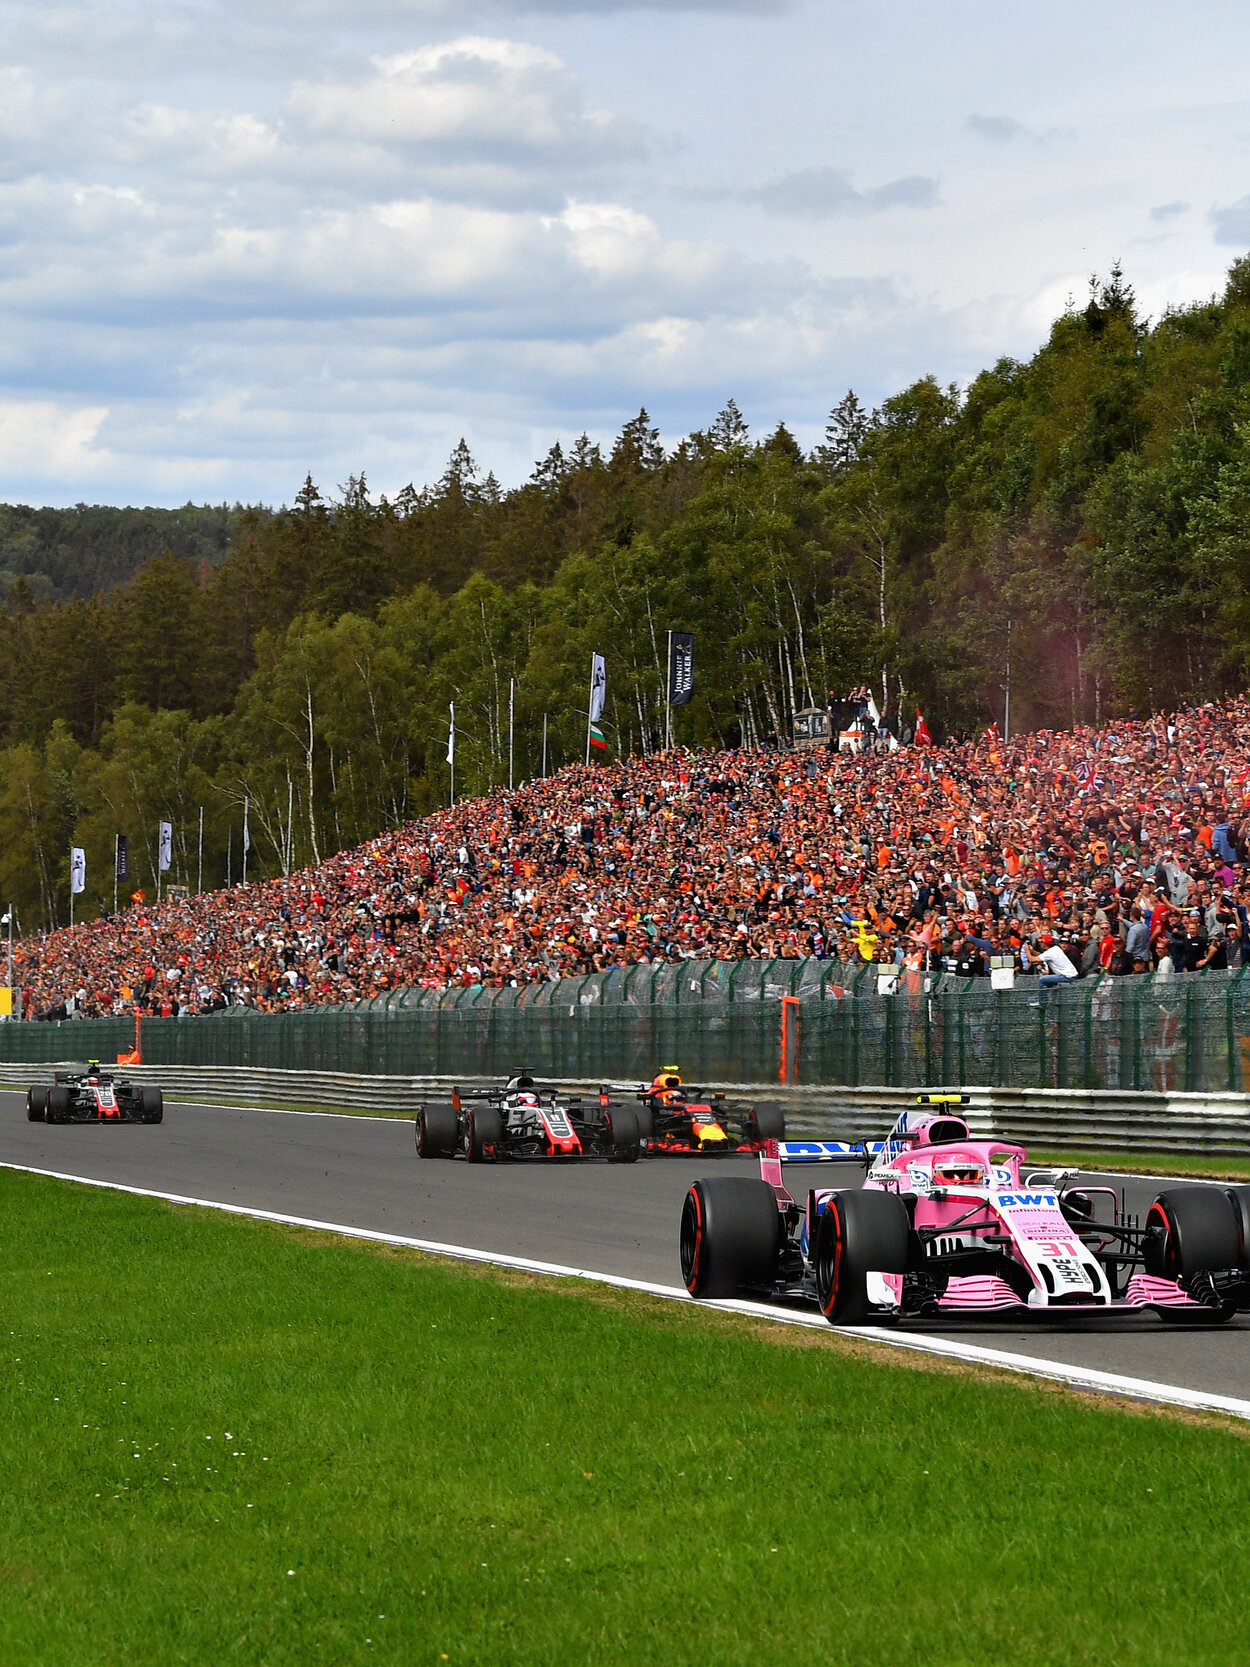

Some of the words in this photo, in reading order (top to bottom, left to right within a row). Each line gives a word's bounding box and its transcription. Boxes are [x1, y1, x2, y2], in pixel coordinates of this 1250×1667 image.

[674, 655, 684, 694] JOHNNIE
[683, 656, 692, 691] WALKER
[998, 1194, 1056, 1207] BWT
[1036, 1242, 1078, 1257] 31
[1051, 1258, 1084, 1284] HYPE
